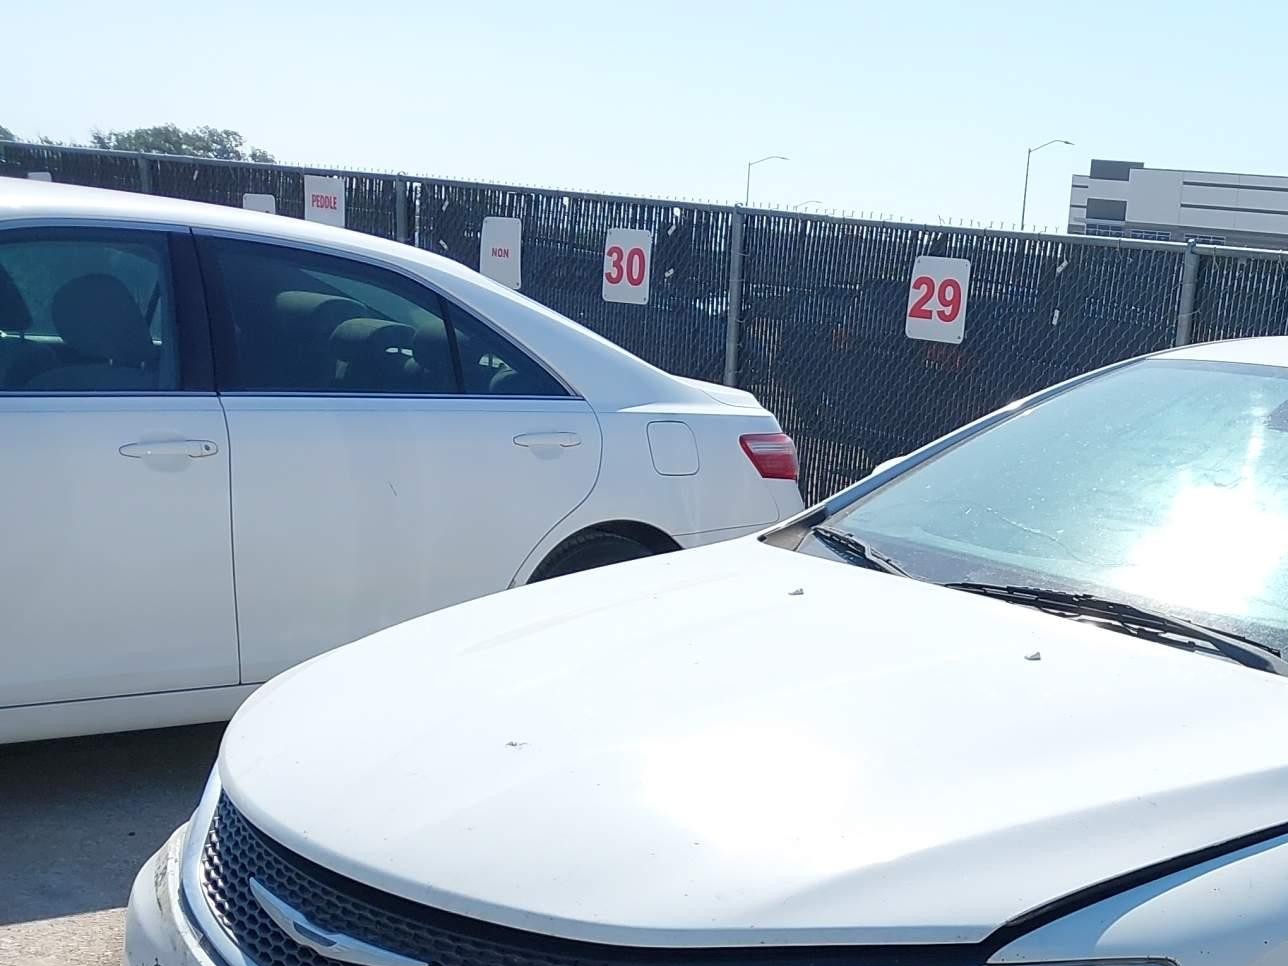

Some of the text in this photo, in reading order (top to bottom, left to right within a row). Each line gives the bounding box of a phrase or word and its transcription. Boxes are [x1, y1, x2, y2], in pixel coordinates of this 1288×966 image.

[311, 194, 337, 210] PEDDLE
[491, 247, 509, 258] NON
[605, 246, 646, 286] 30
[908, 276, 962, 322] 29
